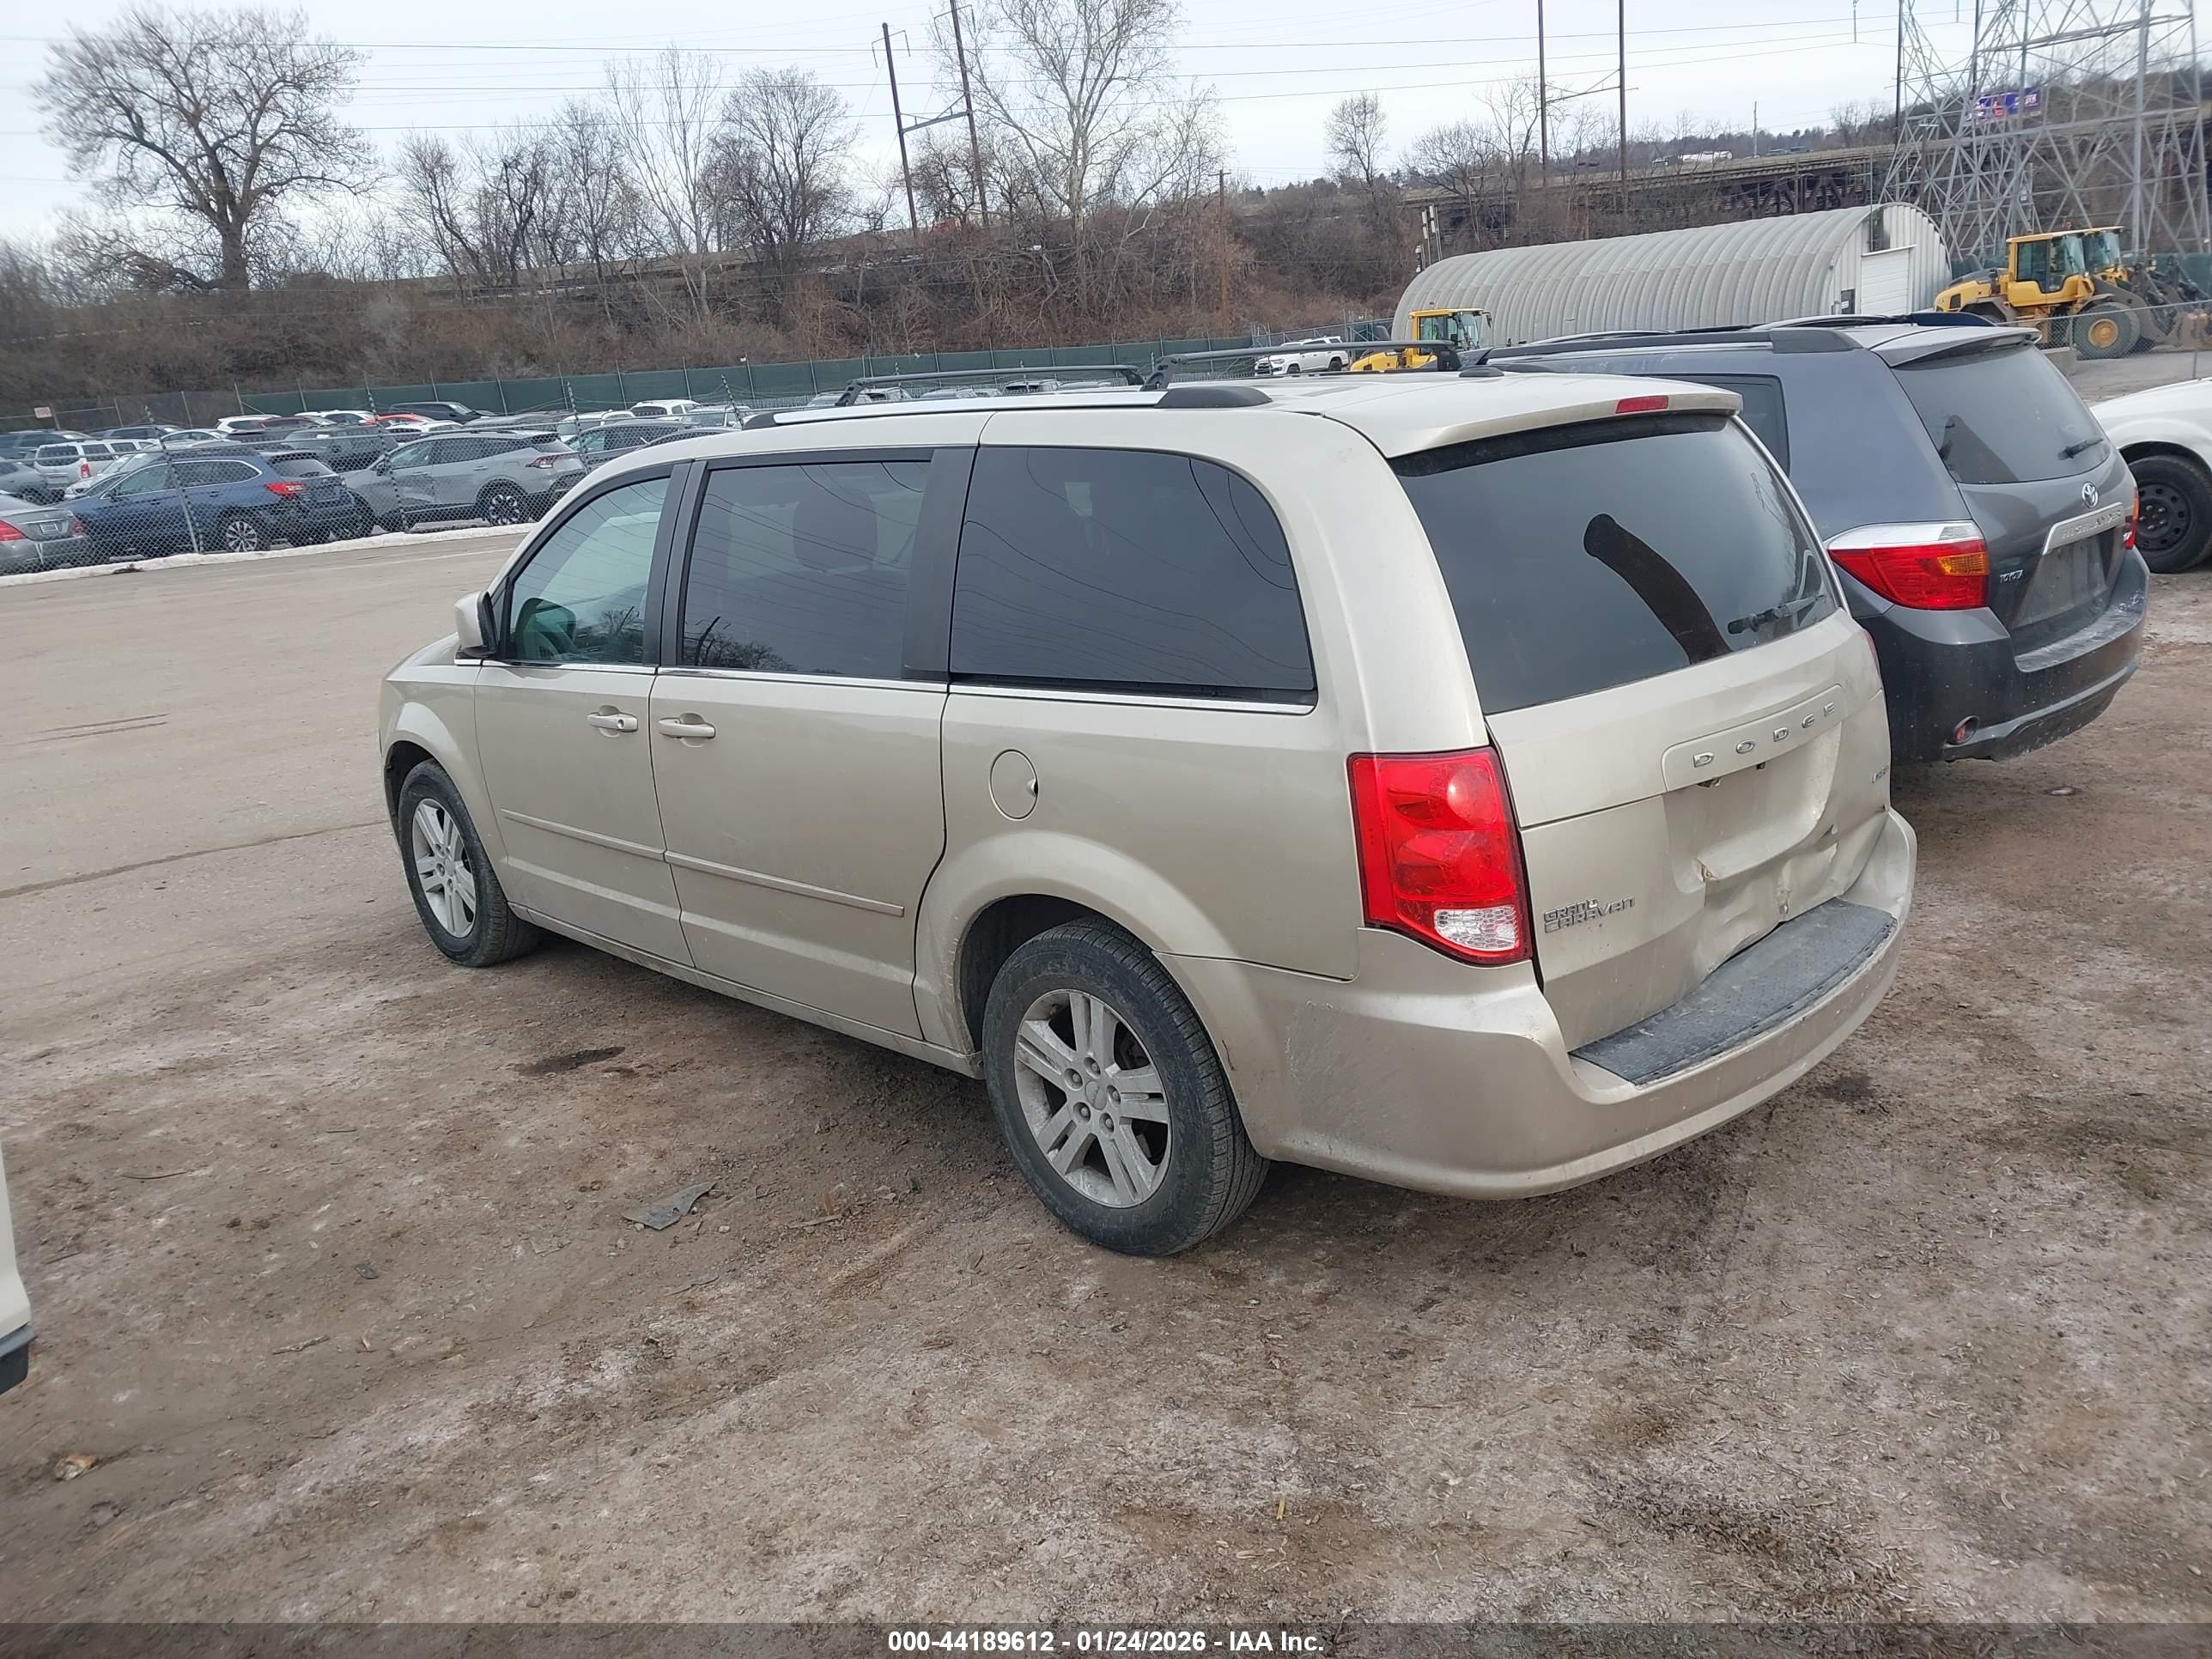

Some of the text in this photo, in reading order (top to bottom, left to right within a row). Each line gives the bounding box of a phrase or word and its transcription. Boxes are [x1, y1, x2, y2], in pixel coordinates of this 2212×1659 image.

[1693, 702, 1835, 768] DODGE
[1544, 898, 1598, 921] GRAND
[1544, 896, 1635, 933] CARAVAN
